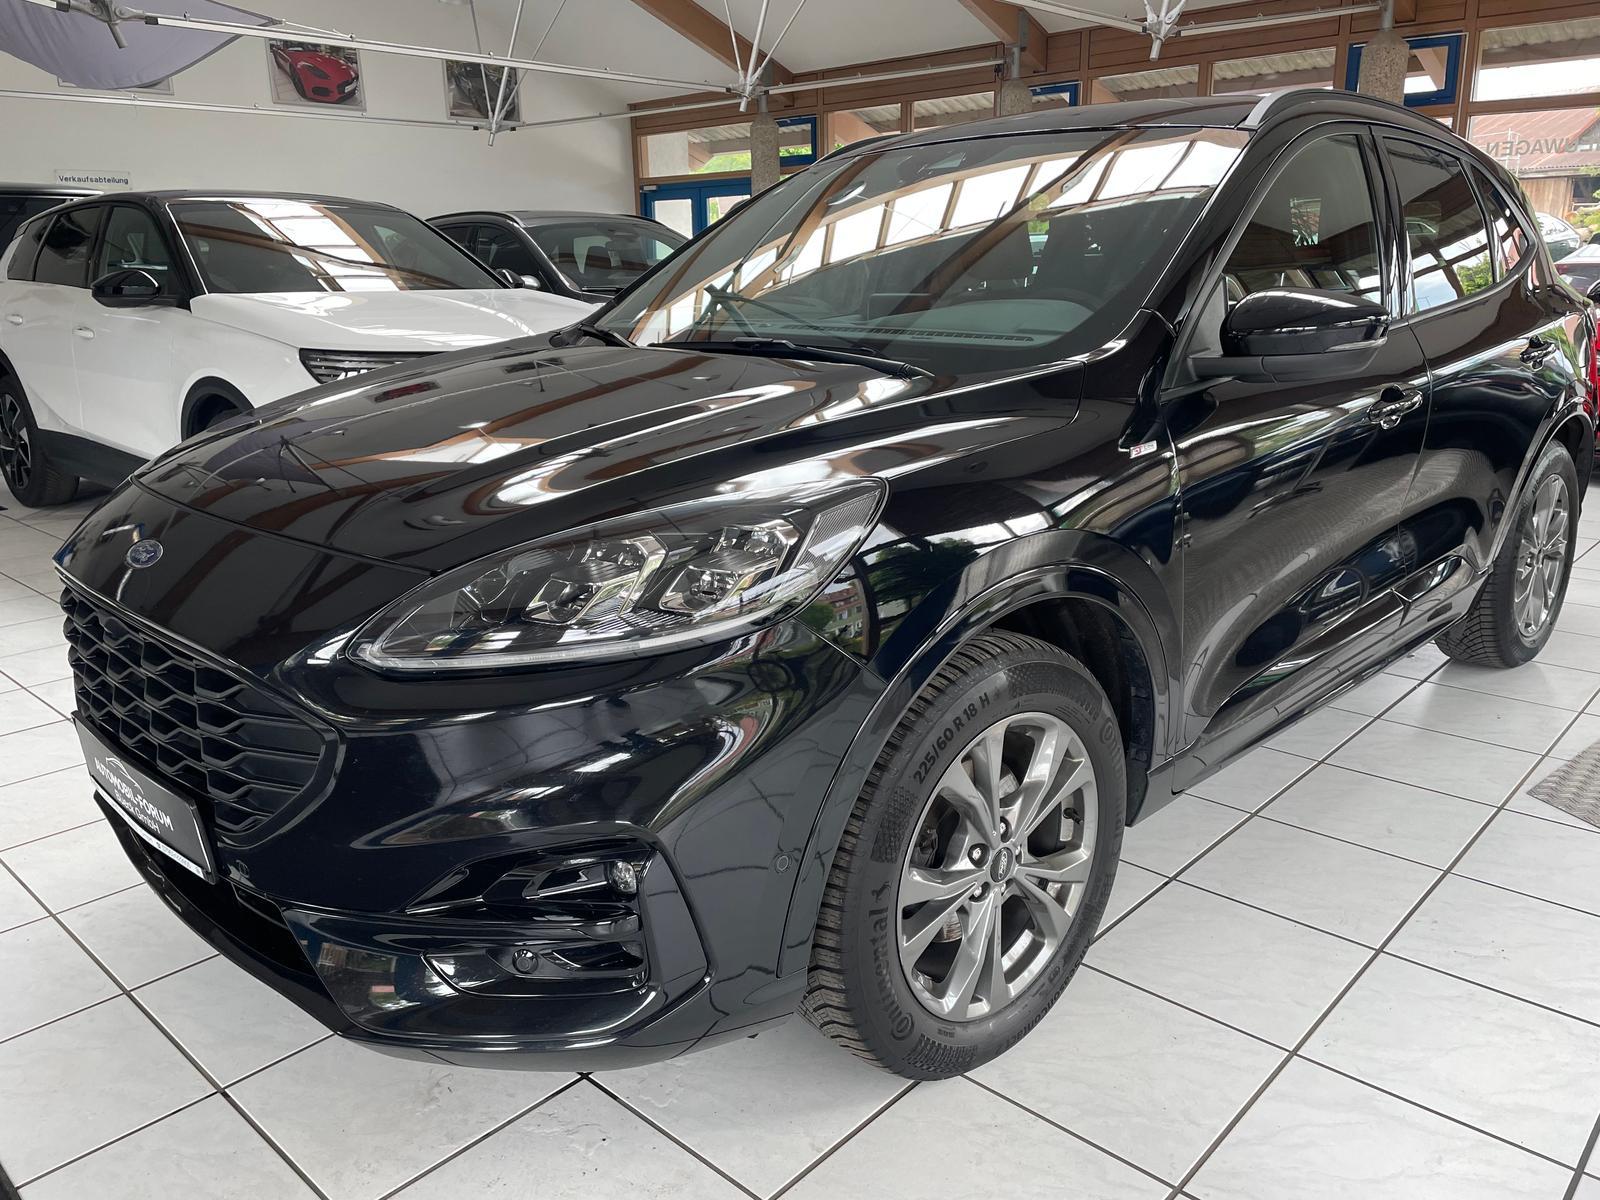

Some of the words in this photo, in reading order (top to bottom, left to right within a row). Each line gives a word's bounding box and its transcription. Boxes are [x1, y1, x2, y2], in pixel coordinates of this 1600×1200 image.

[58, 175, 129, 185] Verkaufsabteilung
[914, 727, 954, 784] 225/60
[953, 717, 965, 732] R
[963, 703, 978, 720] 18
[979, 692, 990, 709] H
[94, 757, 174, 831] AUTOMOBIL-FORUM
[134, 807, 160, 834] GmbH
[998, 851, 1008, 880] Ford
[868, 906, 915, 1041] Continental
